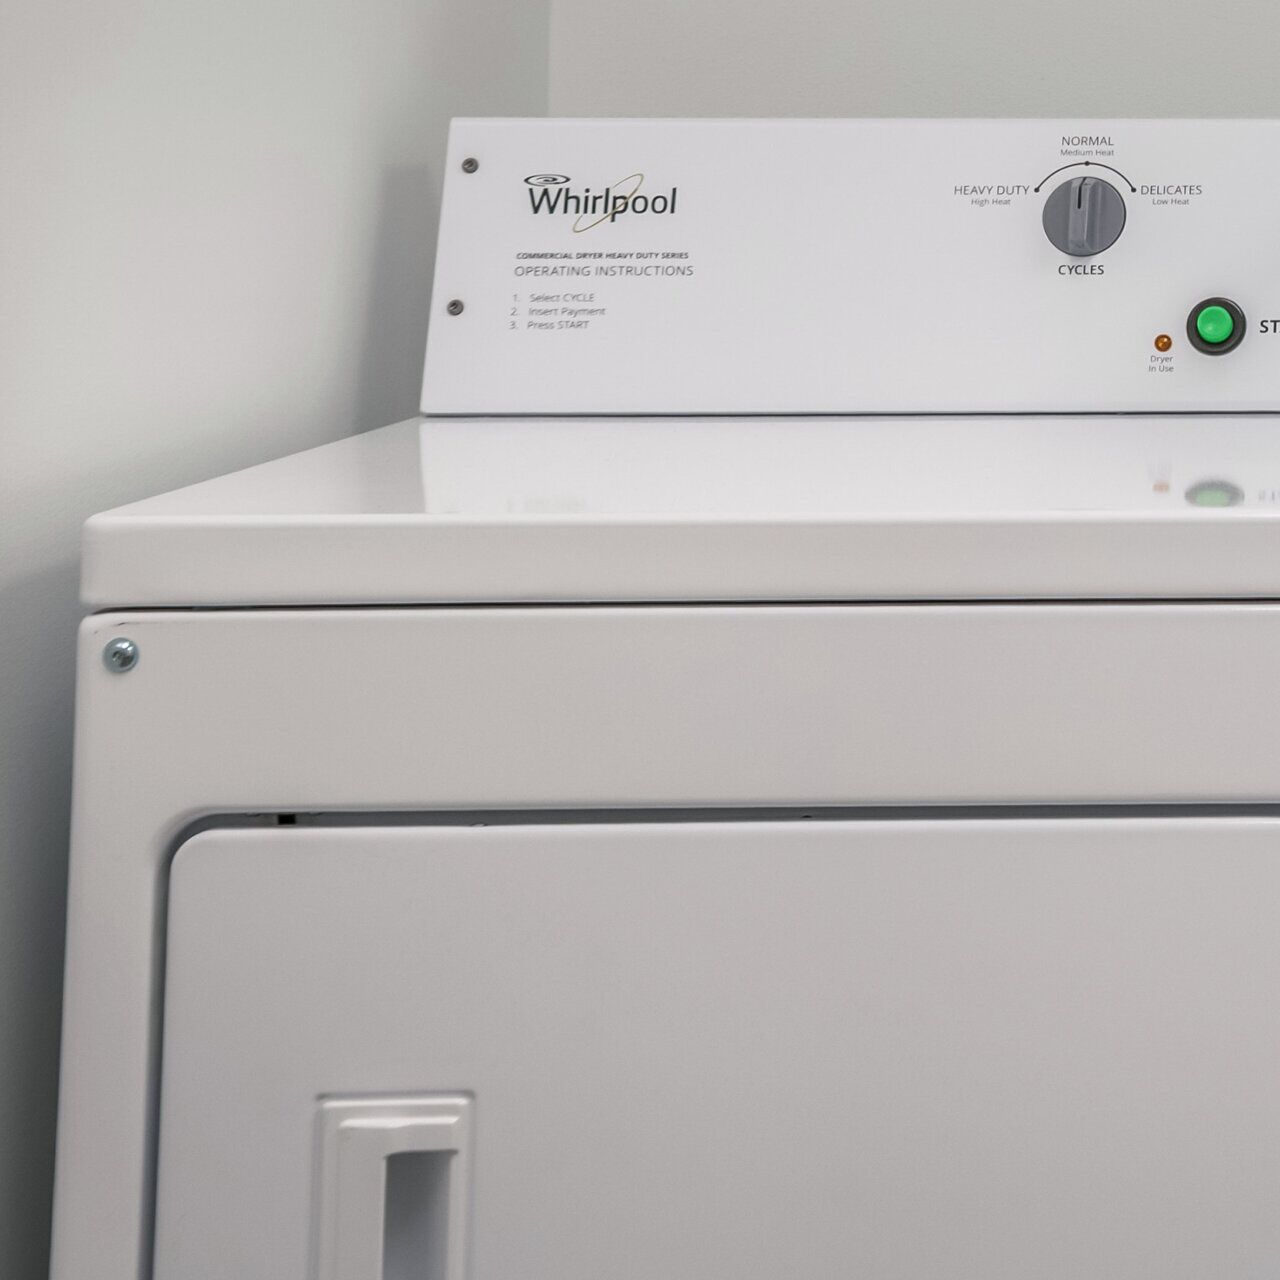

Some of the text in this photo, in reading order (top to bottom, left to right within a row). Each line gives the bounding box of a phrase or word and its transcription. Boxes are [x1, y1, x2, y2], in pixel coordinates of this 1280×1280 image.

[1061, 135, 1114, 147] NORMAL
[1060, 148, 1115, 157] Medium Heat
[953, 184, 1030, 196] HEAVY DUTY
[1140, 184, 1202, 196] DELICATES
[528, 187, 678, 223] Whirlpool
[970, 197, 1011, 207] High Heat
[1152, 197, 1190, 206] Low Heat
[516, 252, 690, 260] COMMERCIAL DRYER HEAVY DUTY SERIES
[514, 265, 694, 277] OPERATING INSTRUCTIONS
[1058, 264, 1105, 276] CYCLES
[530, 293, 560, 303] Select
[562, 293, 595, 303] CYCLE
[528, 307, 559, 317] Insert
[561, 307, 606, 319] Payment
[527, 320, 555, 330] Press
[557, 320, 589, 330] START
[1150, 354, 1173, 365] Dryer
[1149, 365, 1174, 373] In Use
